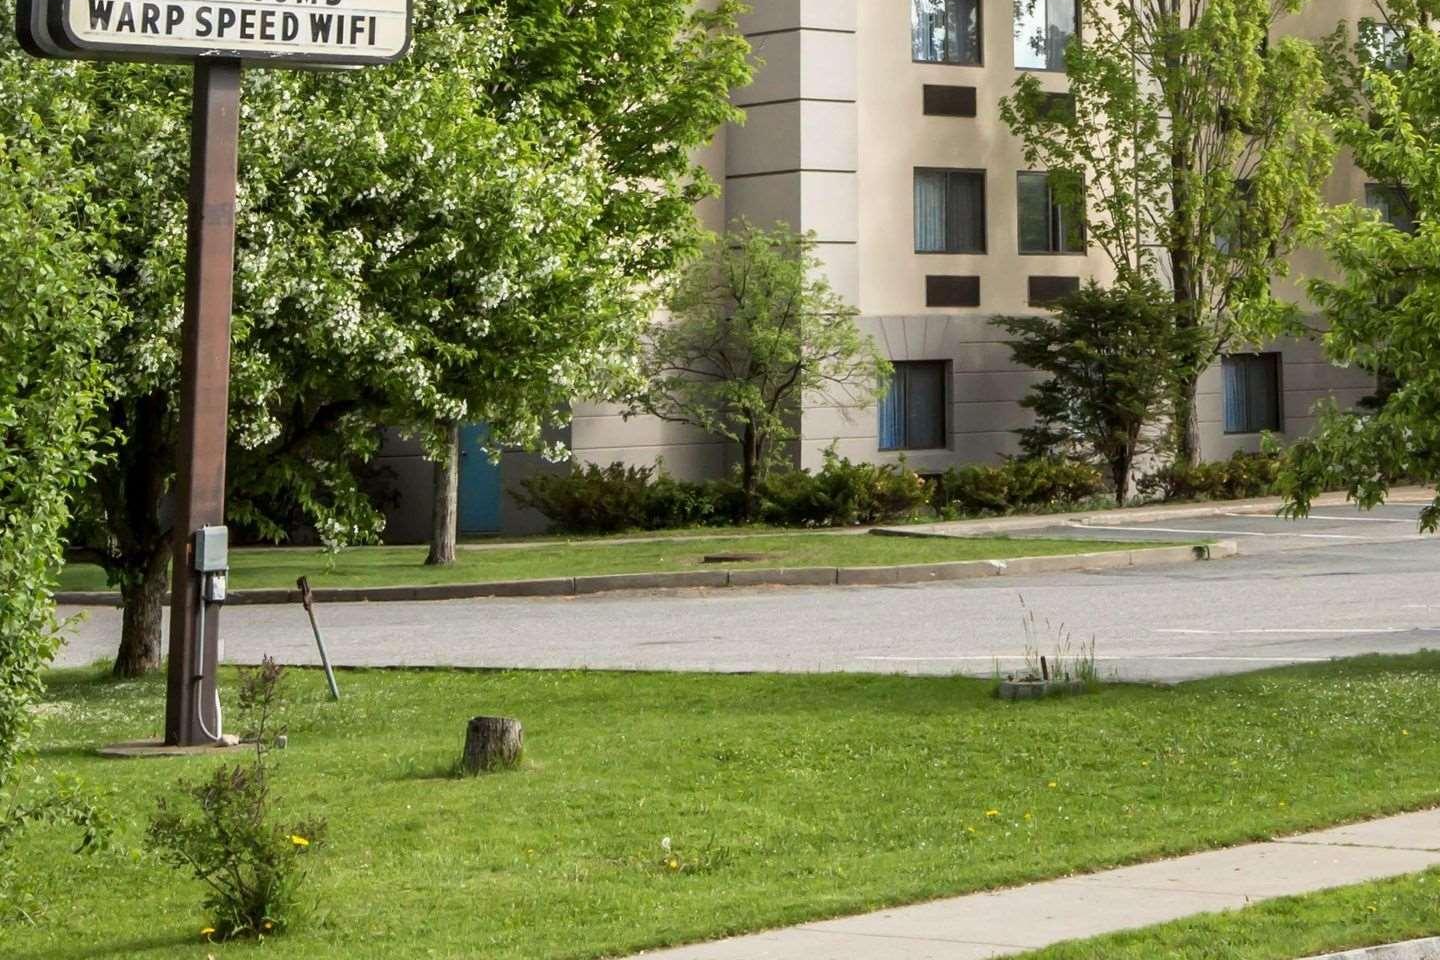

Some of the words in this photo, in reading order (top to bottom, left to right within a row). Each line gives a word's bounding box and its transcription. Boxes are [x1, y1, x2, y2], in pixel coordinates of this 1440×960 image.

[88, 0, 185, 35] WARP
[195, 6, 299, 41] SPEED
[310, 13, 376, 45] WIFI
